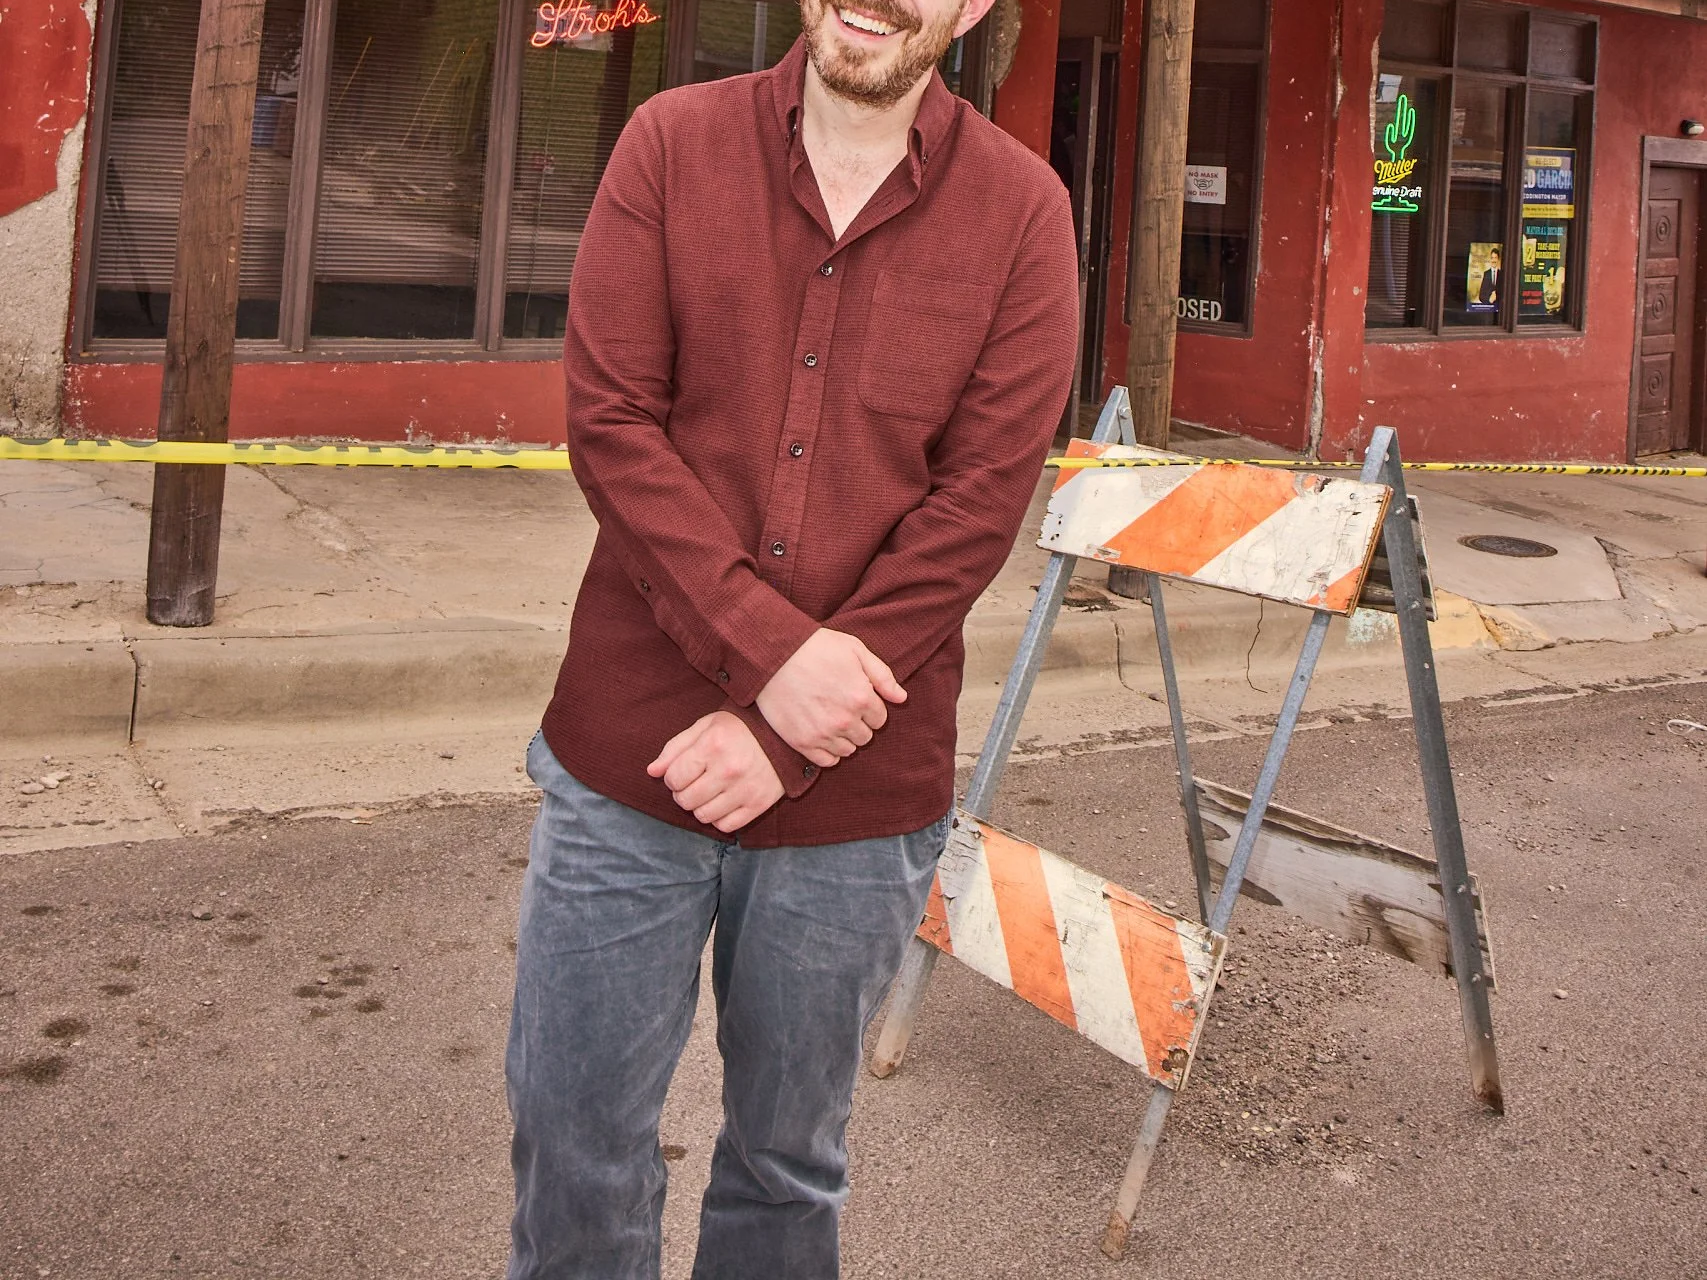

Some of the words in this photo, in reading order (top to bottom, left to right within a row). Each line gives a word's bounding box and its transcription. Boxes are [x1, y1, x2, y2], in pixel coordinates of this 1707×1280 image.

[1374, 158, 1418, 181] Miller
[1523, 168, 1536, 189] ED
[1536, 168, 1573, 190] GARCIA
[1372, 185, 1400, 197] enuine
[1400, 185, 1423, 198] Draft
[1525, 245, 1534, 264] 2
[1177, 296, 1222, 321] OSED
